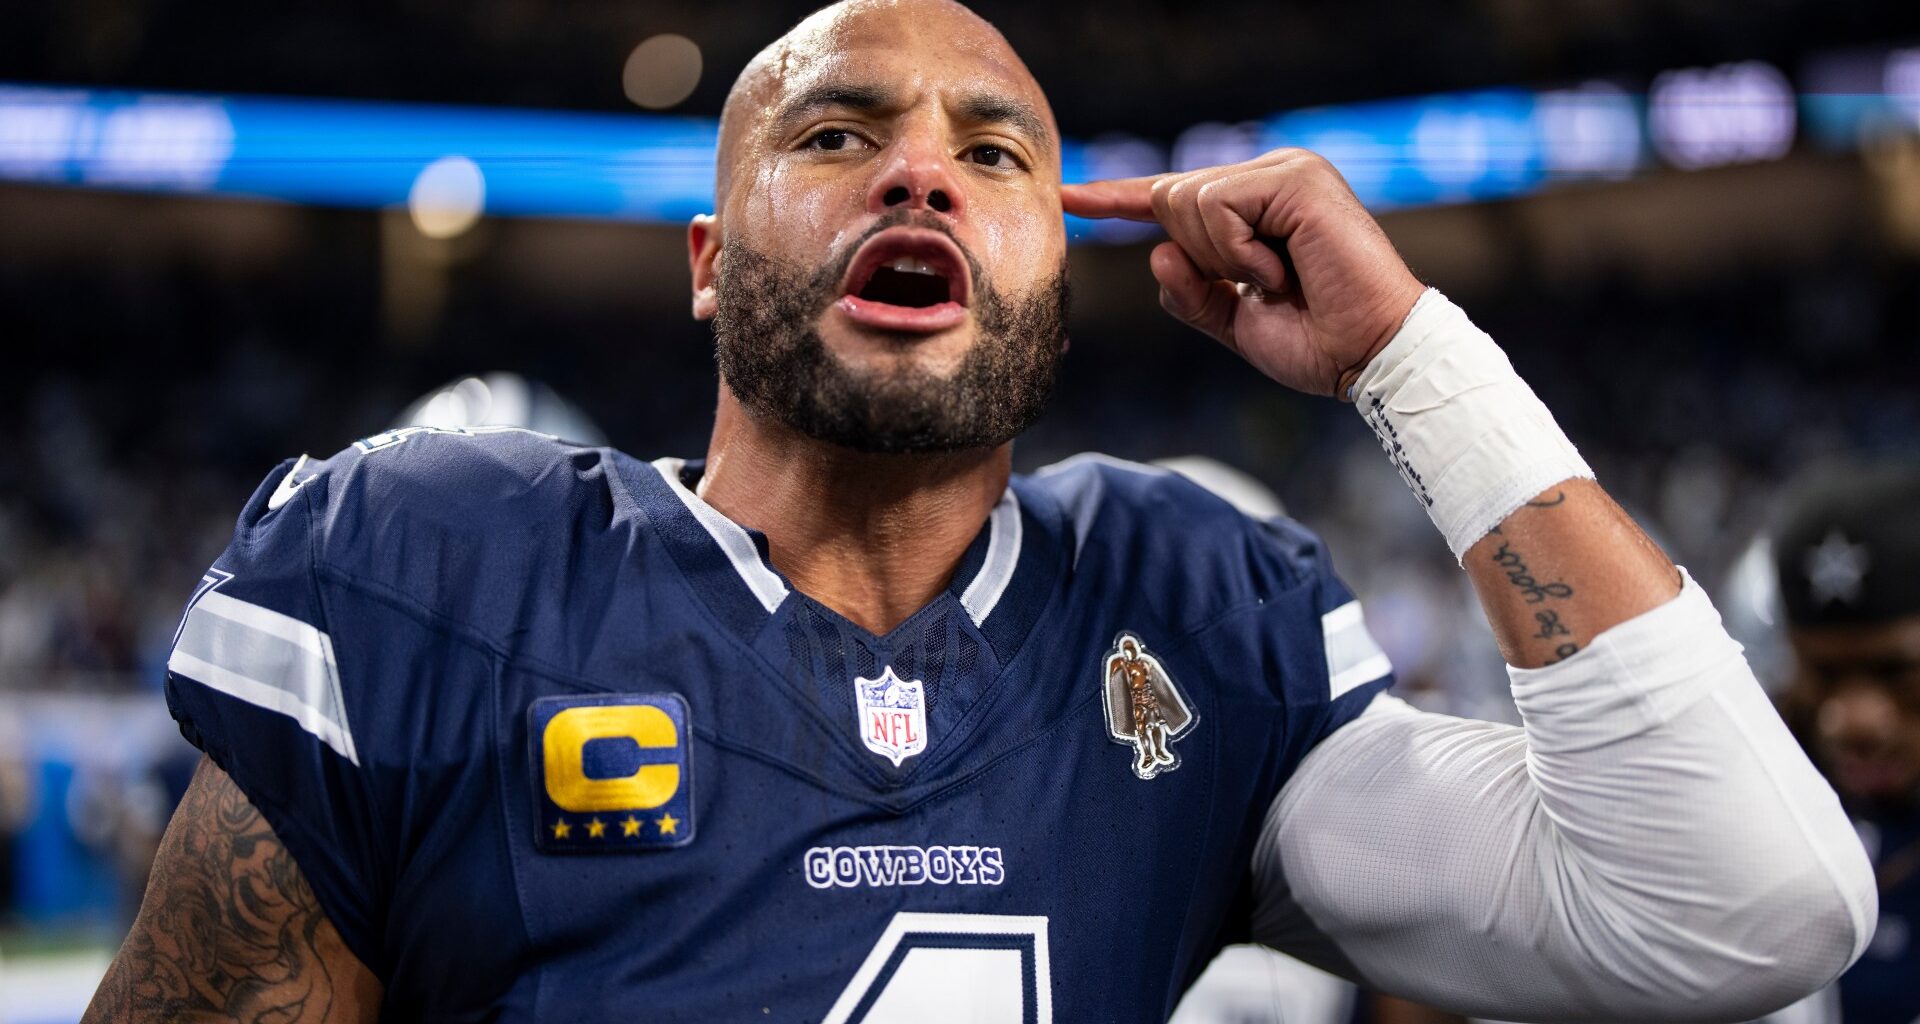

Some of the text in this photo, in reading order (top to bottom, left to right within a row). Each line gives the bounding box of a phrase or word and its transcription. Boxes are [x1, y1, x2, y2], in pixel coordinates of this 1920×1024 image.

[1493, 539, 1573, 604] your
[872, 712, 918, 747] NFL
[543, 704, 680, 813] C
[804, 846, 1004, 888] COWBOYS
